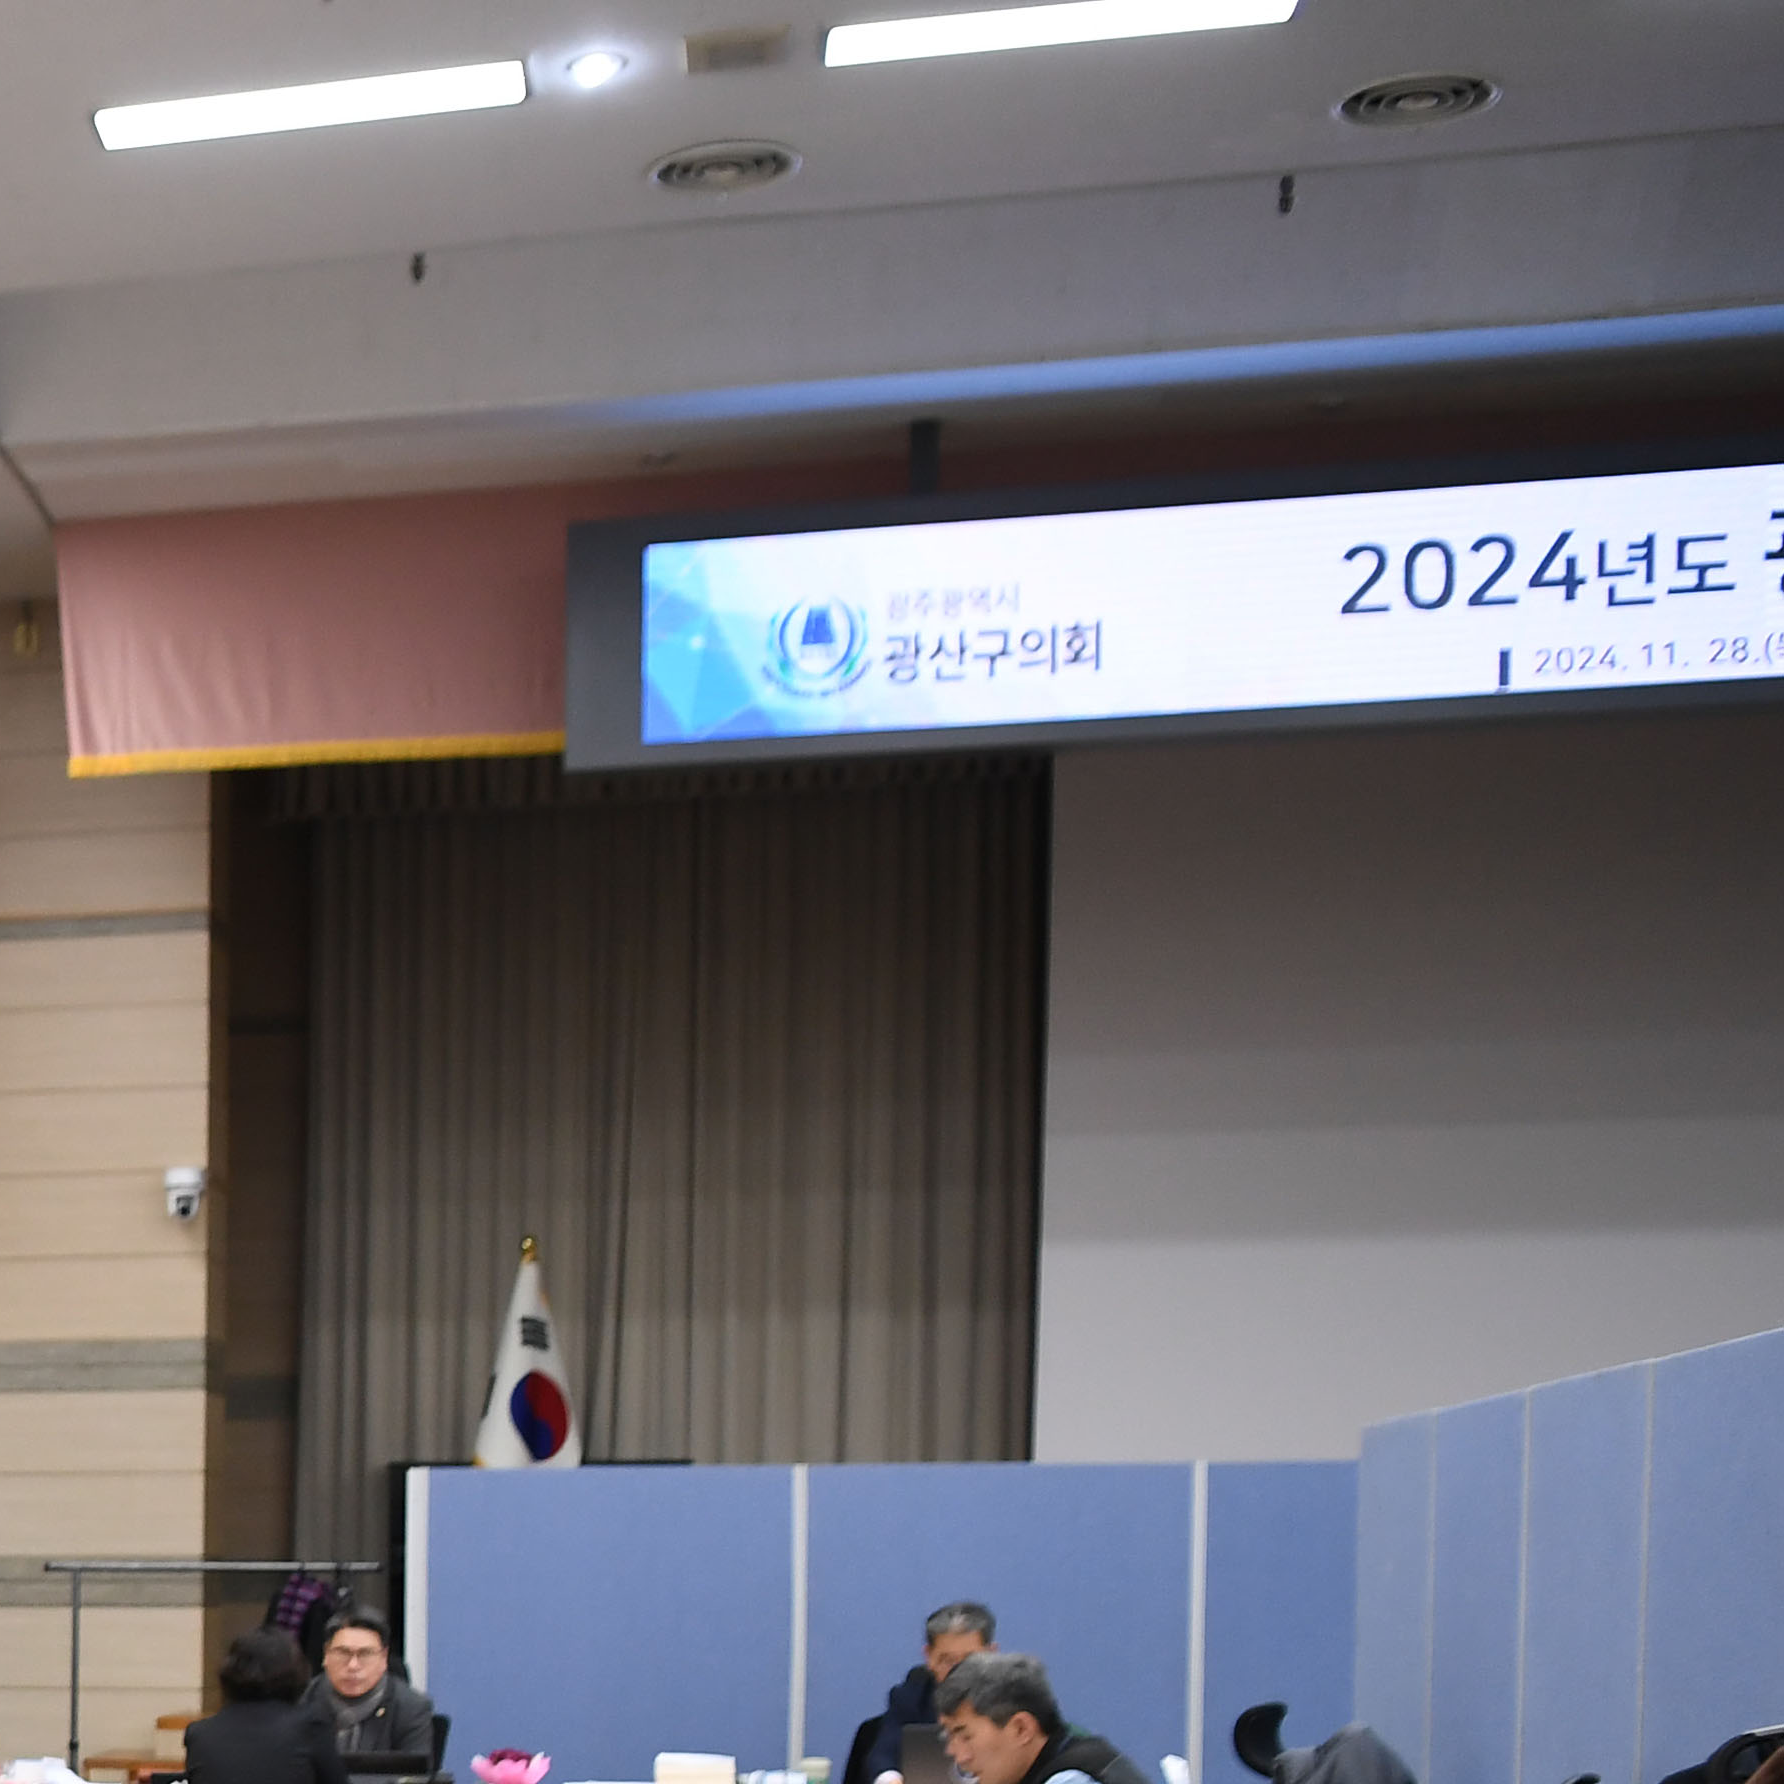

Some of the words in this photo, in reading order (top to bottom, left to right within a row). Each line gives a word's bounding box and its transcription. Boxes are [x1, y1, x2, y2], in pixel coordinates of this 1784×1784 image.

[1340, 529, 1736, 615] 2024년도
[886, 581, 1021, 621] 광주광역시
[883, 619, 1102, 683] 광산구의회
[1534, 643, 1628, 674] 2024.
[1641, 641, 1690, 668] 11.
